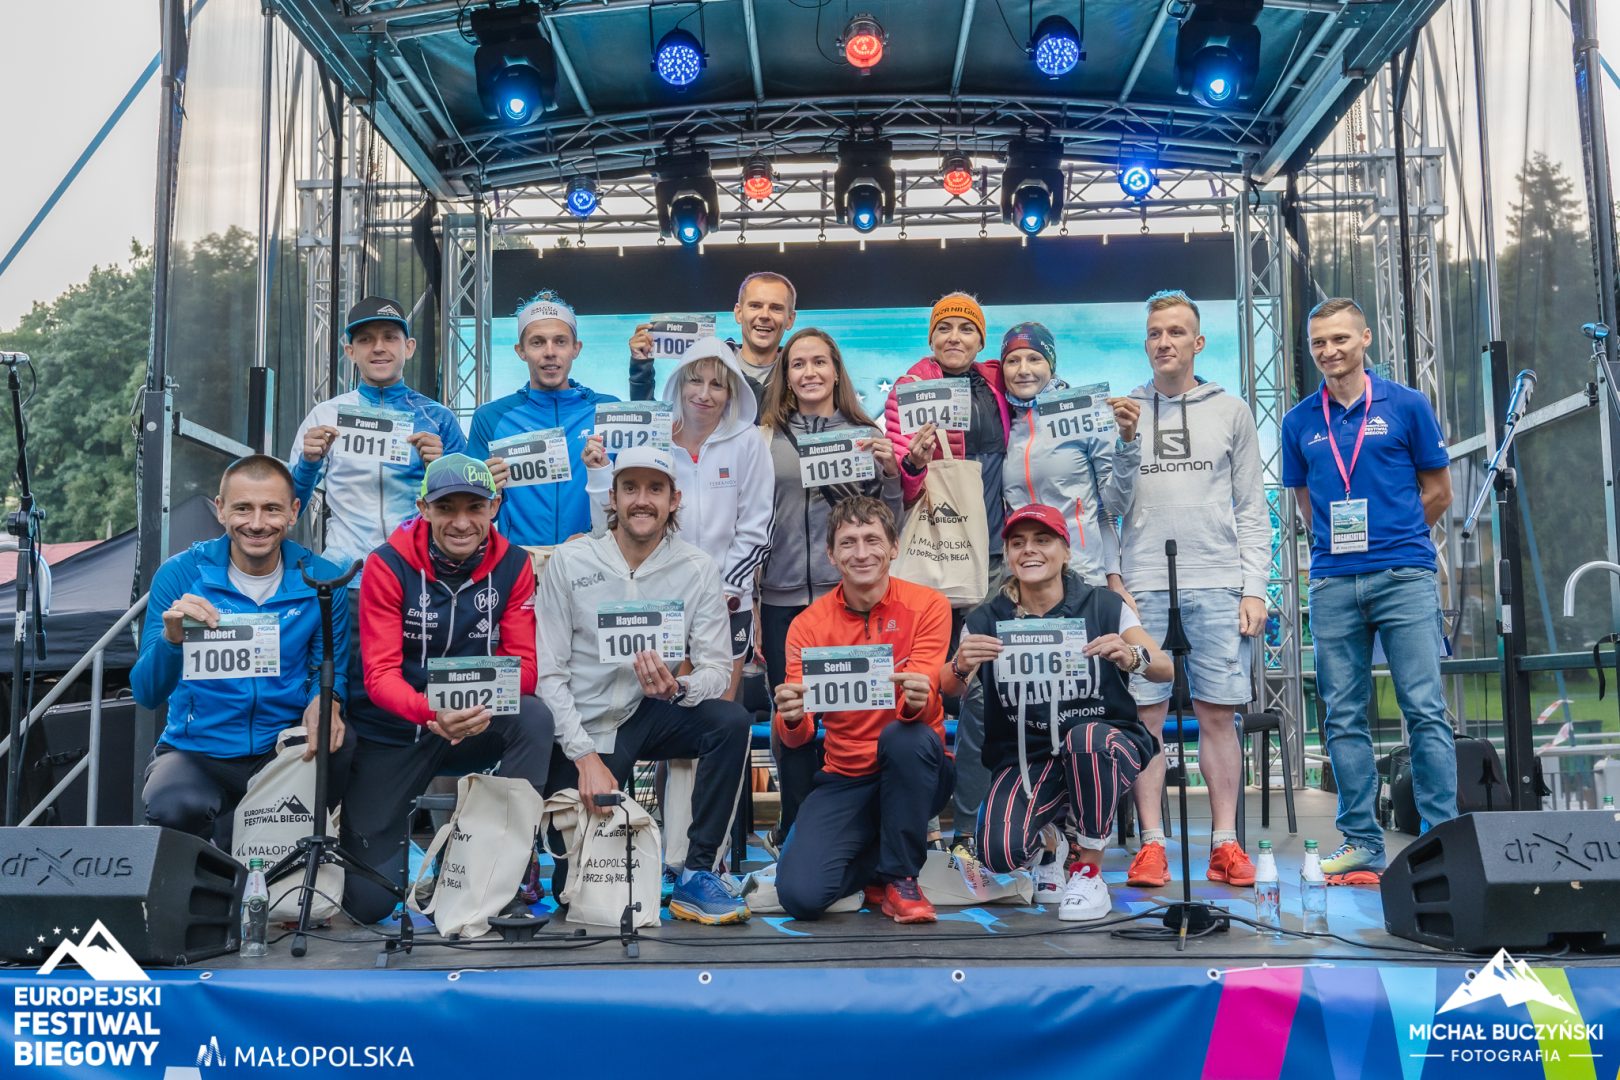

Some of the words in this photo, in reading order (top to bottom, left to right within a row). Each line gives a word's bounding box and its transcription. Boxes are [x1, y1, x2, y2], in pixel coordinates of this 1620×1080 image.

[666, 323, 684, 332] Piotr
[653, 338, 695, 355] 1005
[915, 391, 937, 402] Edyta
[1059, 402, 1074, 411] Ewa
[606, 413, 643, 423] Dominika
[904, 405, 951, 428] 1014
[1046, 414, 1094, 438] 1015
[341, 434, 386, 457] 1011
[600, 430, 649, 449] 1012
[507, 445, 531, 455] Kamil
[808, 443, 846, 455] Alexandra
[510, 460, 547, 481] 006
[806, 458, 853, 481] 1013
[935, 515, 969, 524] BIEGOWY
[950, 553, 970, 561] BIEGA
[615, 616, 648, 626] Hayden
[203, 628, 236, 640] Robert
[468, 631, 490, 639] Colum
[1010, 633, 1054, 643] Katarzyna
[605, 633, 657, 656] 1001
[190, 648, 251, 672] 1008
[1005, 651, 1062, 675] 1016
[824, 661, 852, 673] Serhii
[448, 672, 481, 682] Marcin
[810, 680, 868, 705] 1010
[435, 688, 493, 710] 1002
[1057, 706, 1105, 726] HAMPIONS
[244, 807, 276, 817] EUROPEJSKI
[244, 815, 279, 827] FESTIWAL
[280, 814, 315, 823] BIEGOW
[248, 845, 297, 856] MAŁOPO
[586, 858, 641, 868] AŁOPOLSA
